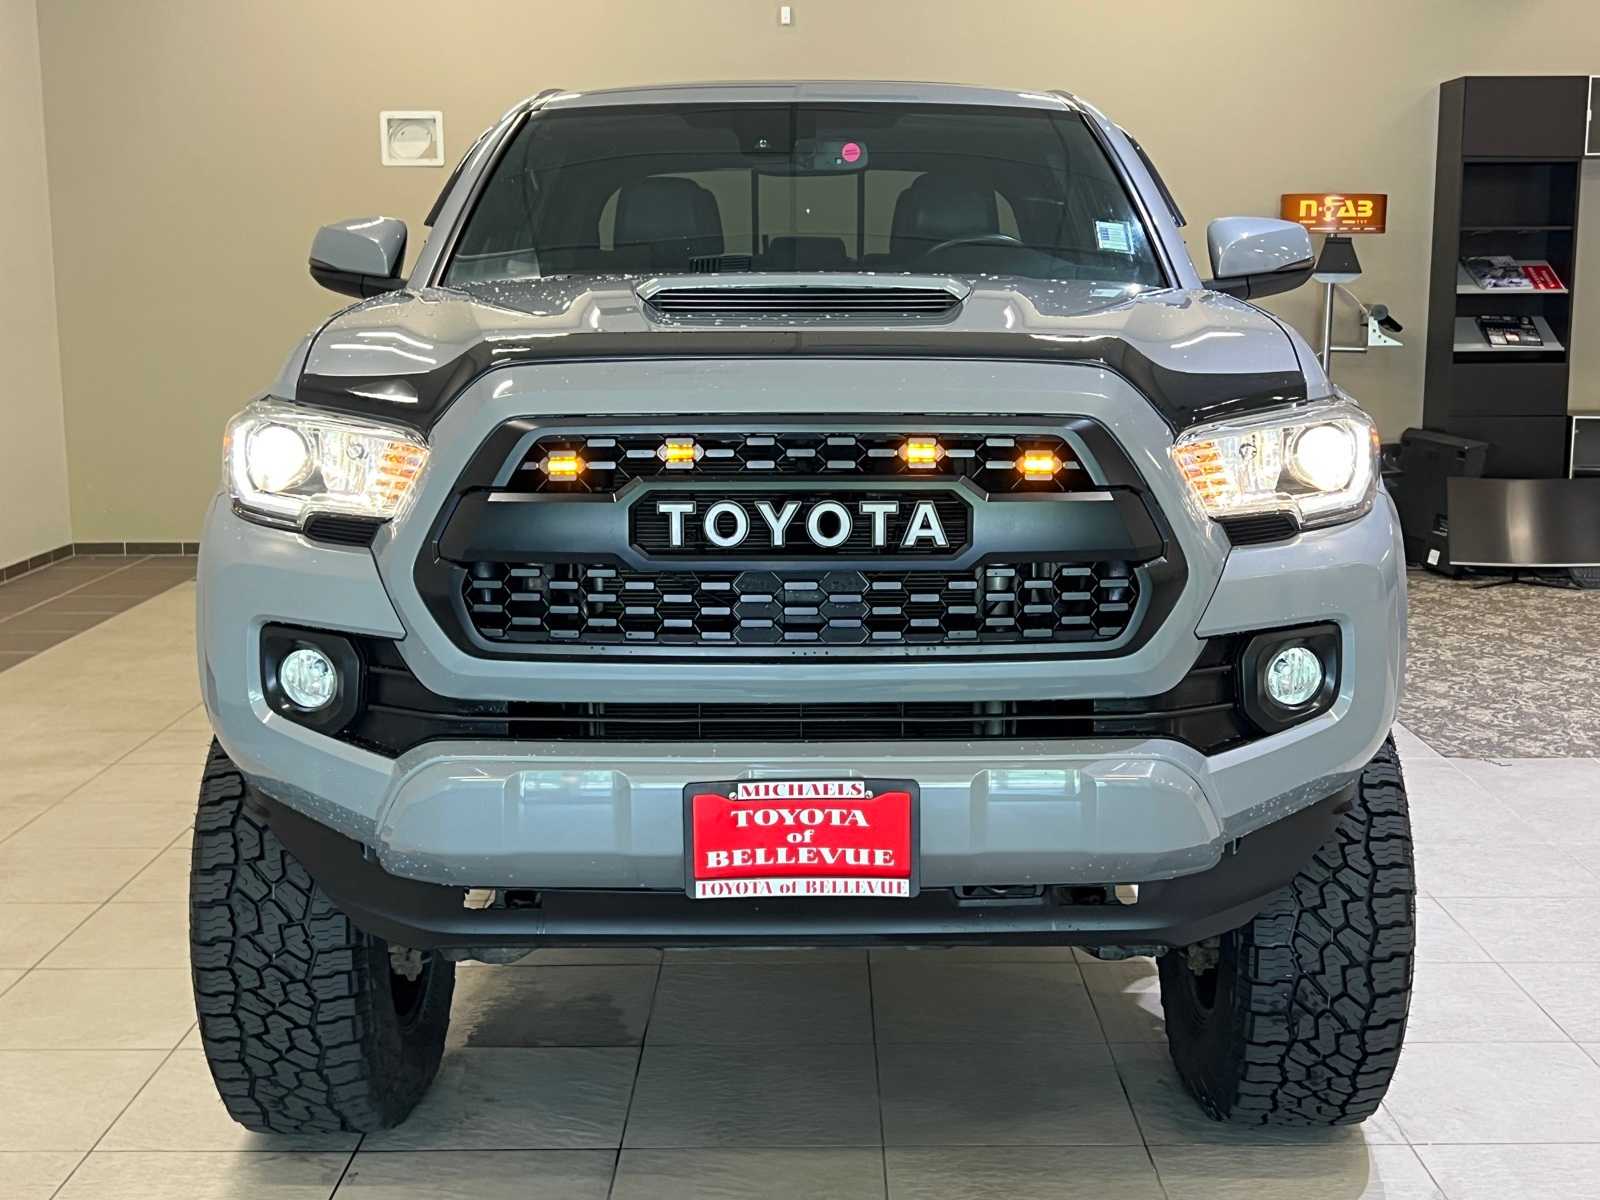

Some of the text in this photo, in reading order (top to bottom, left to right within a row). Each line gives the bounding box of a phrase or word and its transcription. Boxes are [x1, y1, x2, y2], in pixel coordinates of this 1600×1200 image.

[657, 500, 949, 548] TOYOTA
[741, 783, 863, 797] MICHAELS
[731, 808, 869, 827] TOYOTA
[786, 829, 815, 843] of
[706, 847, 895, 868] BELLEVUE
[700, 880, 908, 896] TOYOTA of BELLEVUE
